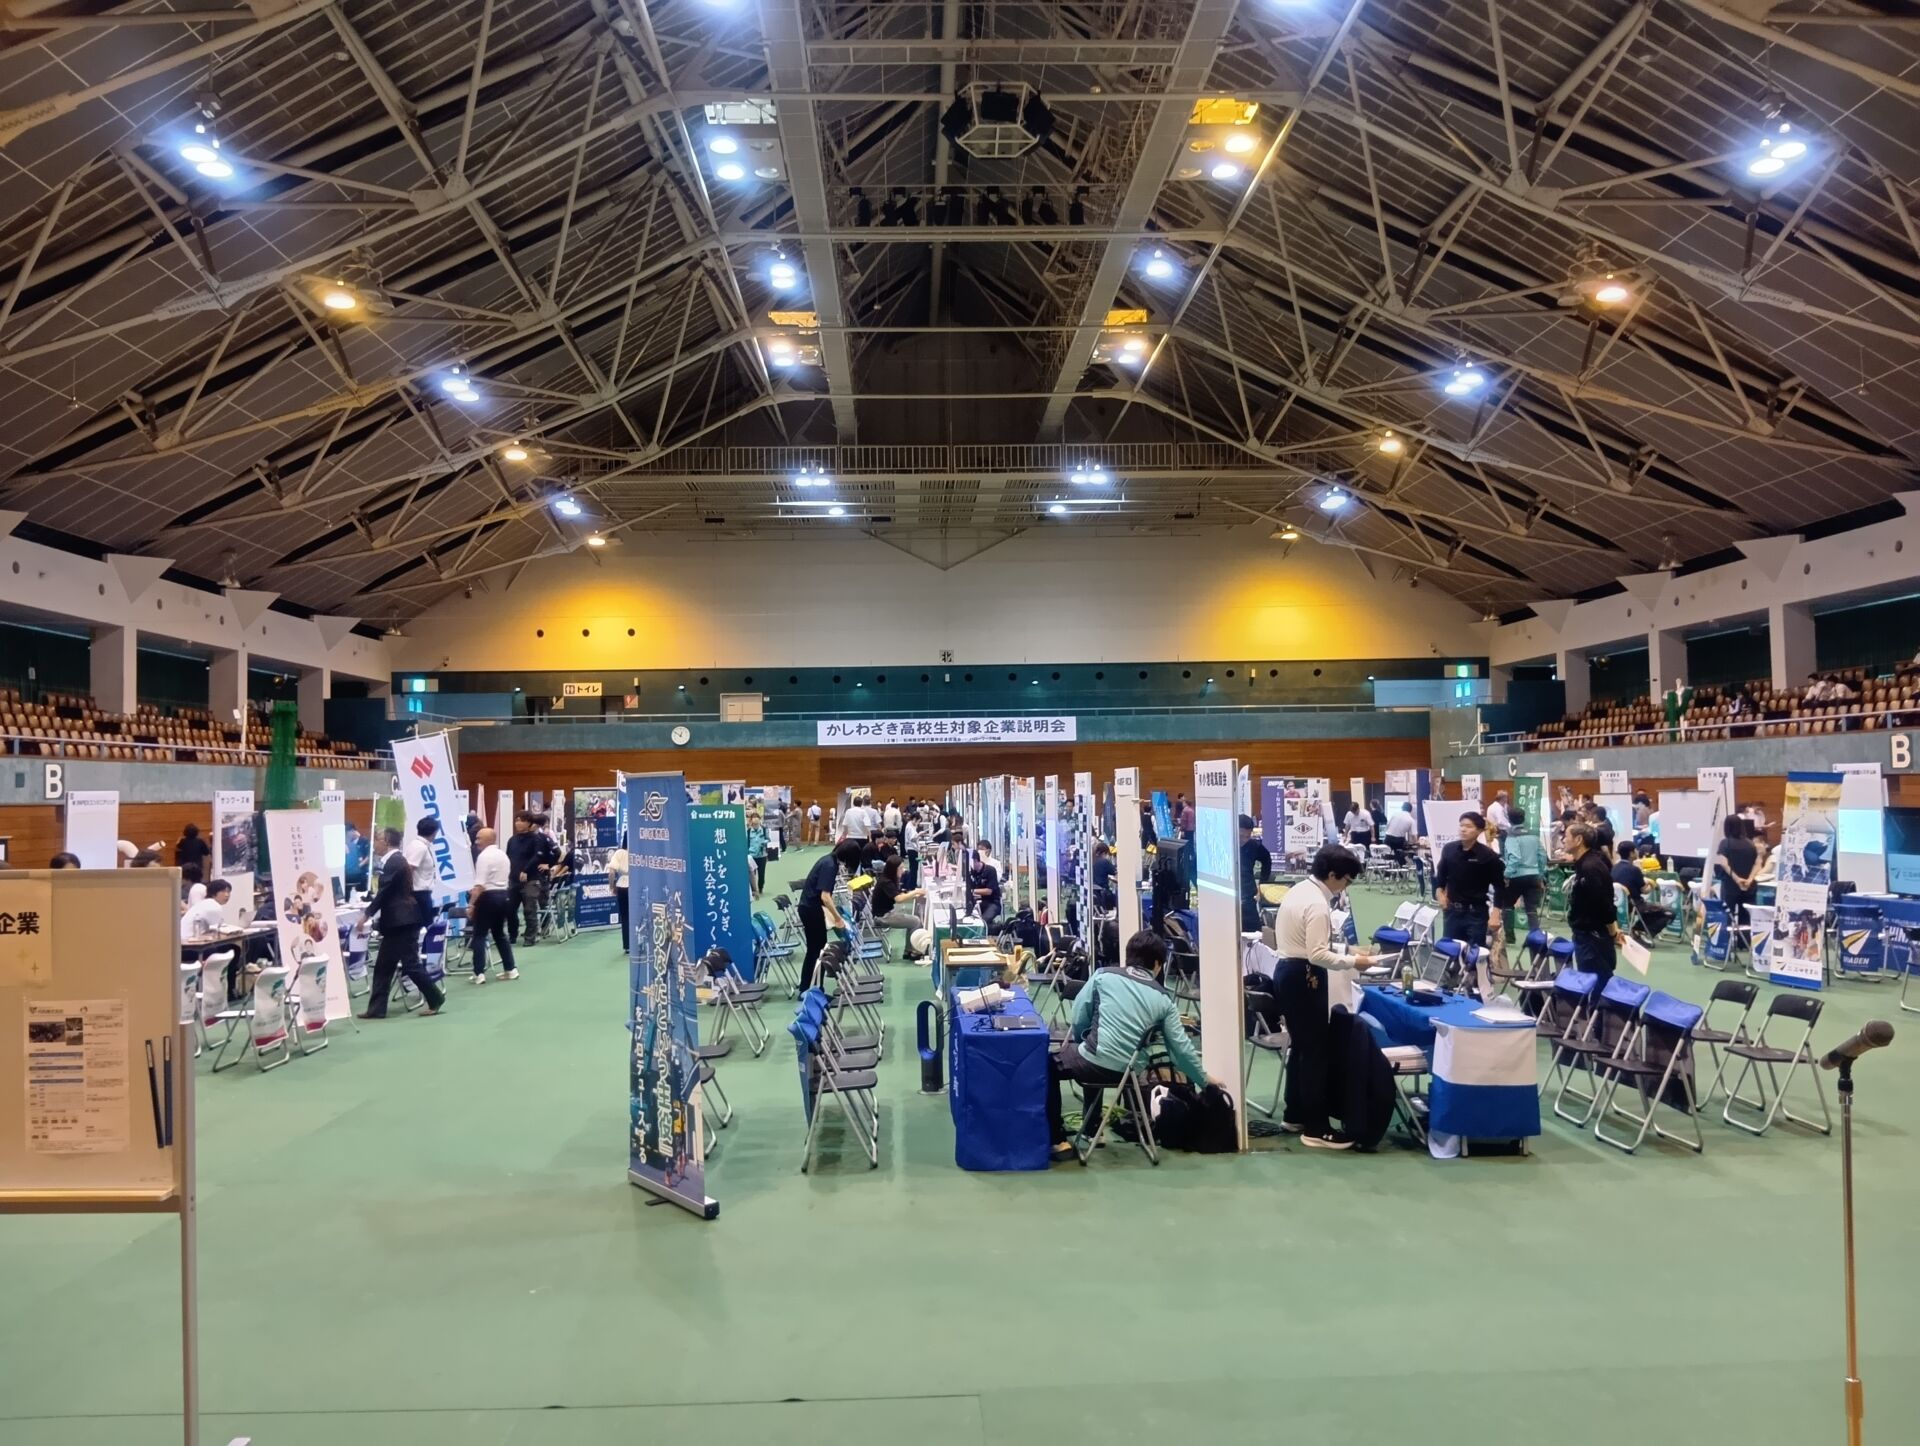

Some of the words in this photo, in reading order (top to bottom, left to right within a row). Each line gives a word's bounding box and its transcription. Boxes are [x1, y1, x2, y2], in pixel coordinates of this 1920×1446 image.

[942, 651, 952, 662] 北
[577, 685, 599, 693] トイレ
[827, 719, 1066, 736] かしわざき高校生対象企業説明会
[1891, 735, 1911, 769] B
[1508, 758, 1517, 776] C
[45, 764, 63, 799] B
[391, 775, 398, 792] C
[714, 828, 733, 937] 想いをつなぎ、
[703, 856, 718, 950] 社会をつく
[0, 911, 39, 935] 企業
[634, 1005, 647, 1164] をプロデュースする
